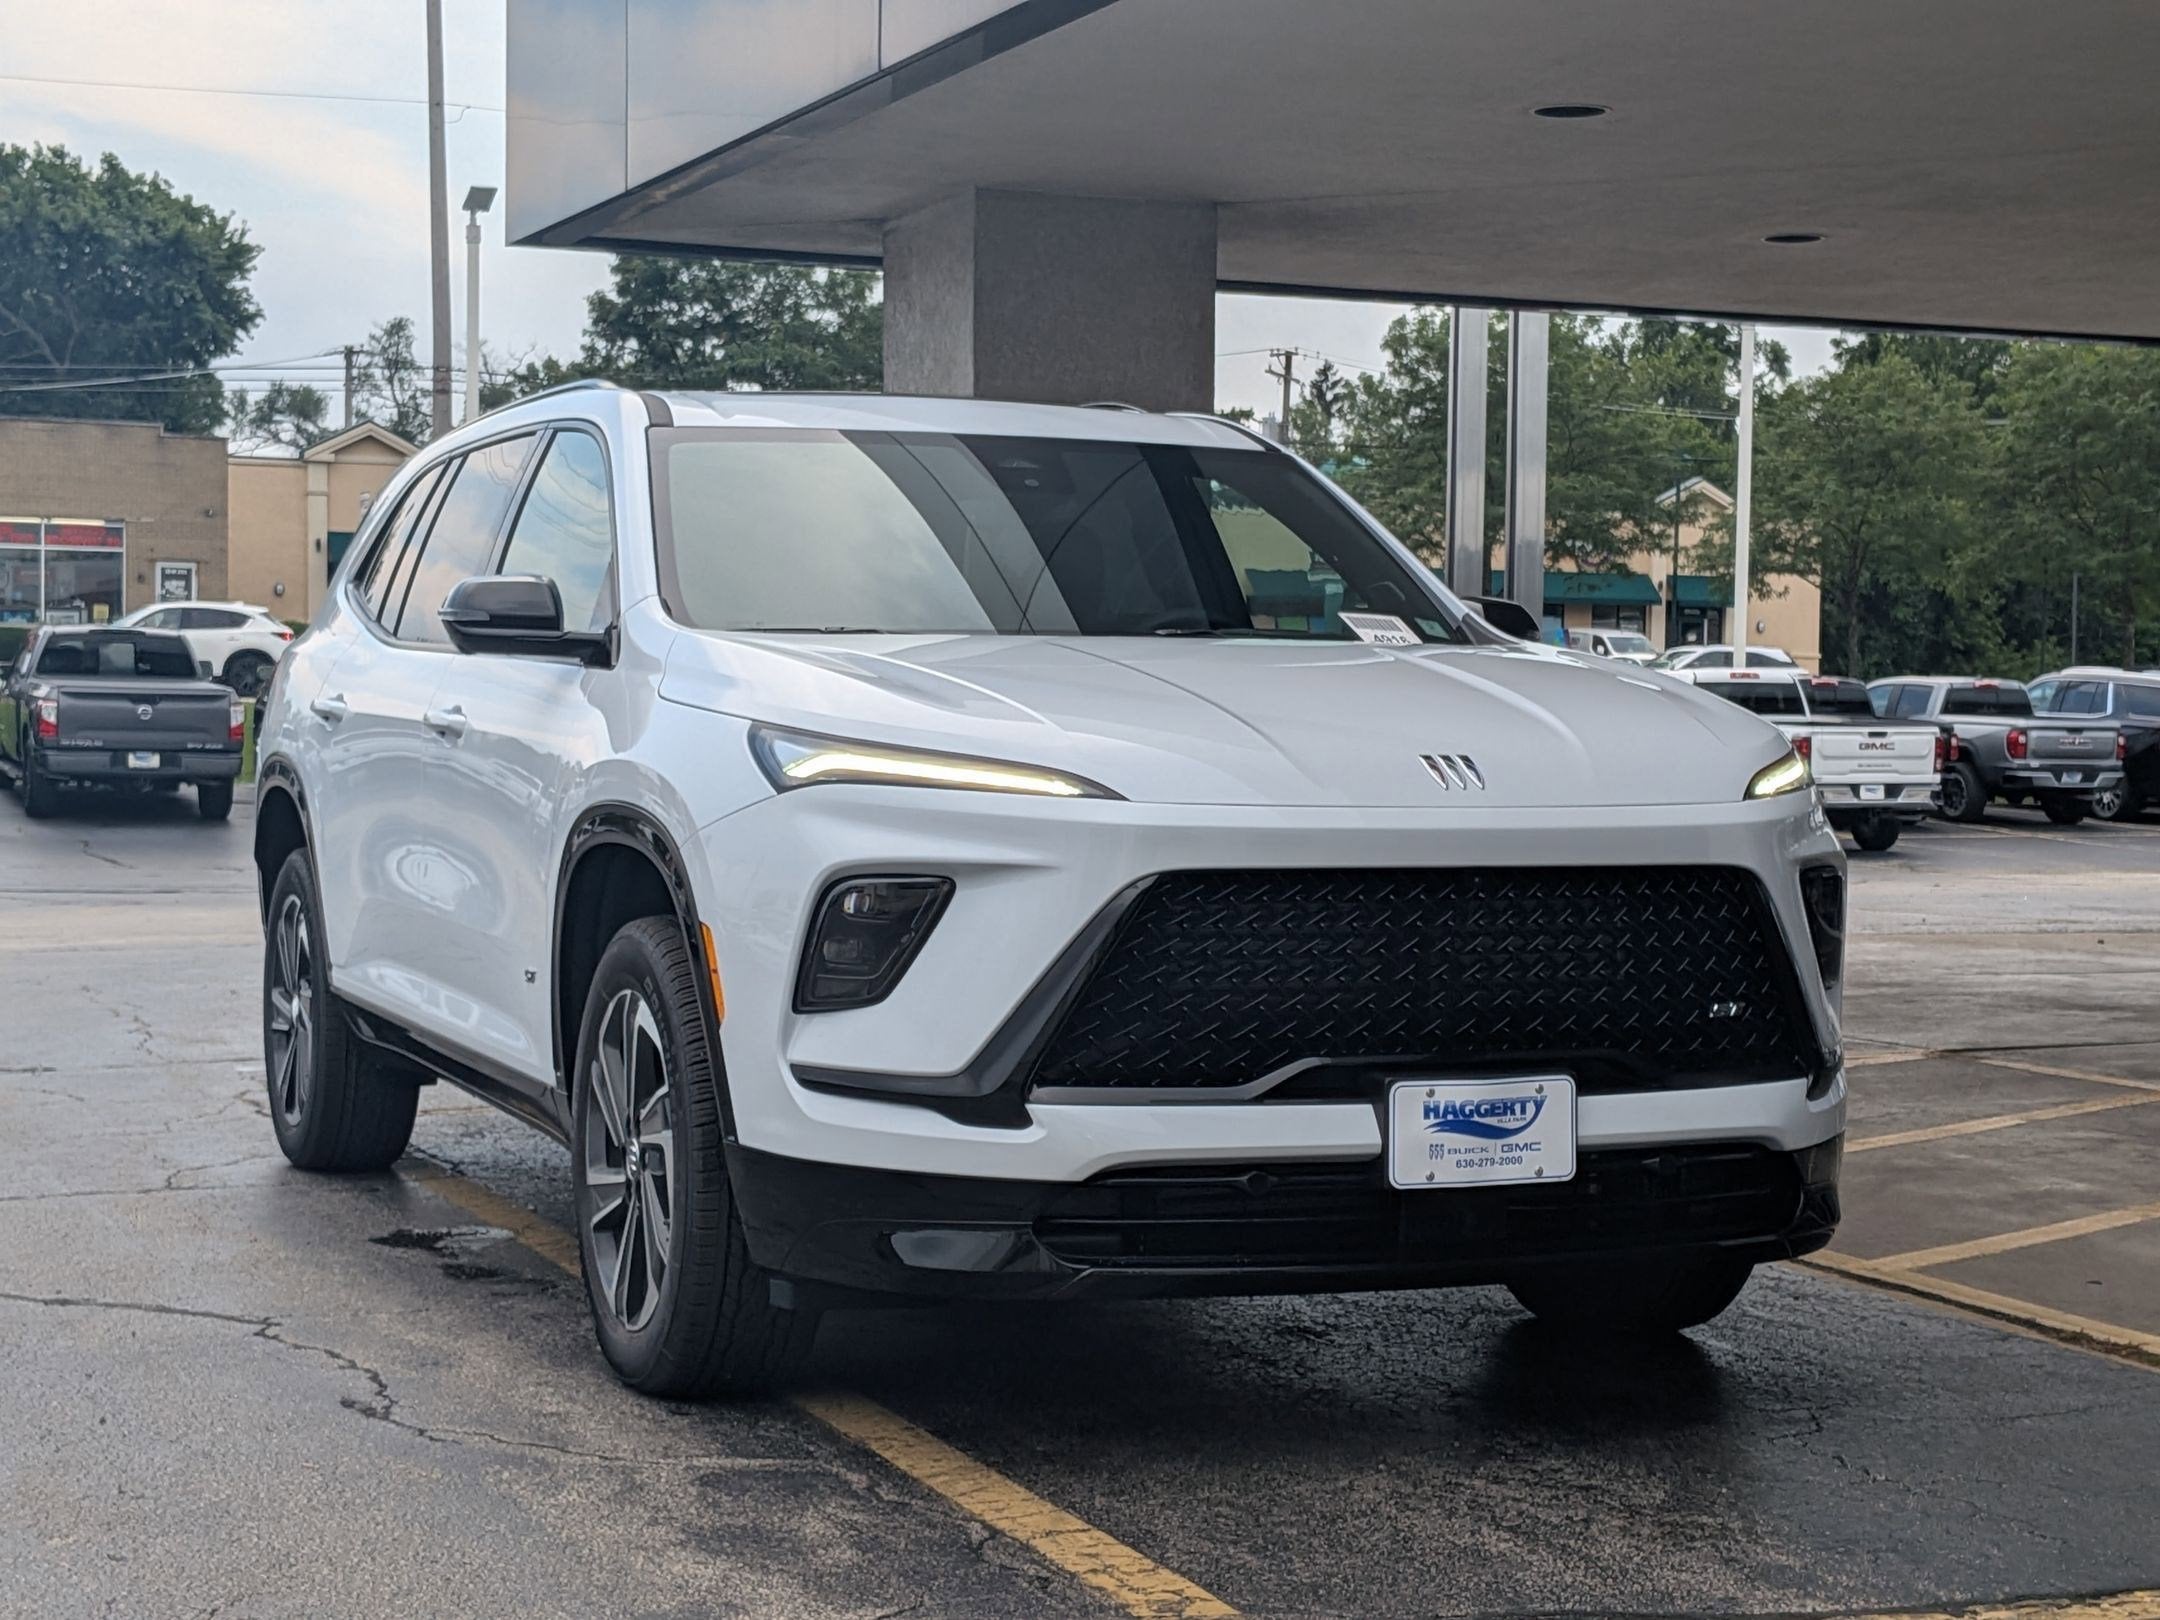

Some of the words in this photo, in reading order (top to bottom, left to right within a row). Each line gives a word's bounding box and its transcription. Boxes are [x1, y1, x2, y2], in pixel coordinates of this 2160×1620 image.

[1859, 742, 1895, 750] GMC
[1423, 1095, 1548, 1121] HAGGERTY
[1448, 1146, 1489, 1155] BUICK
[1501, 1142, 1541, 1153] GMC
[1456, 1156, 1523, 1169] 630-279-2000
